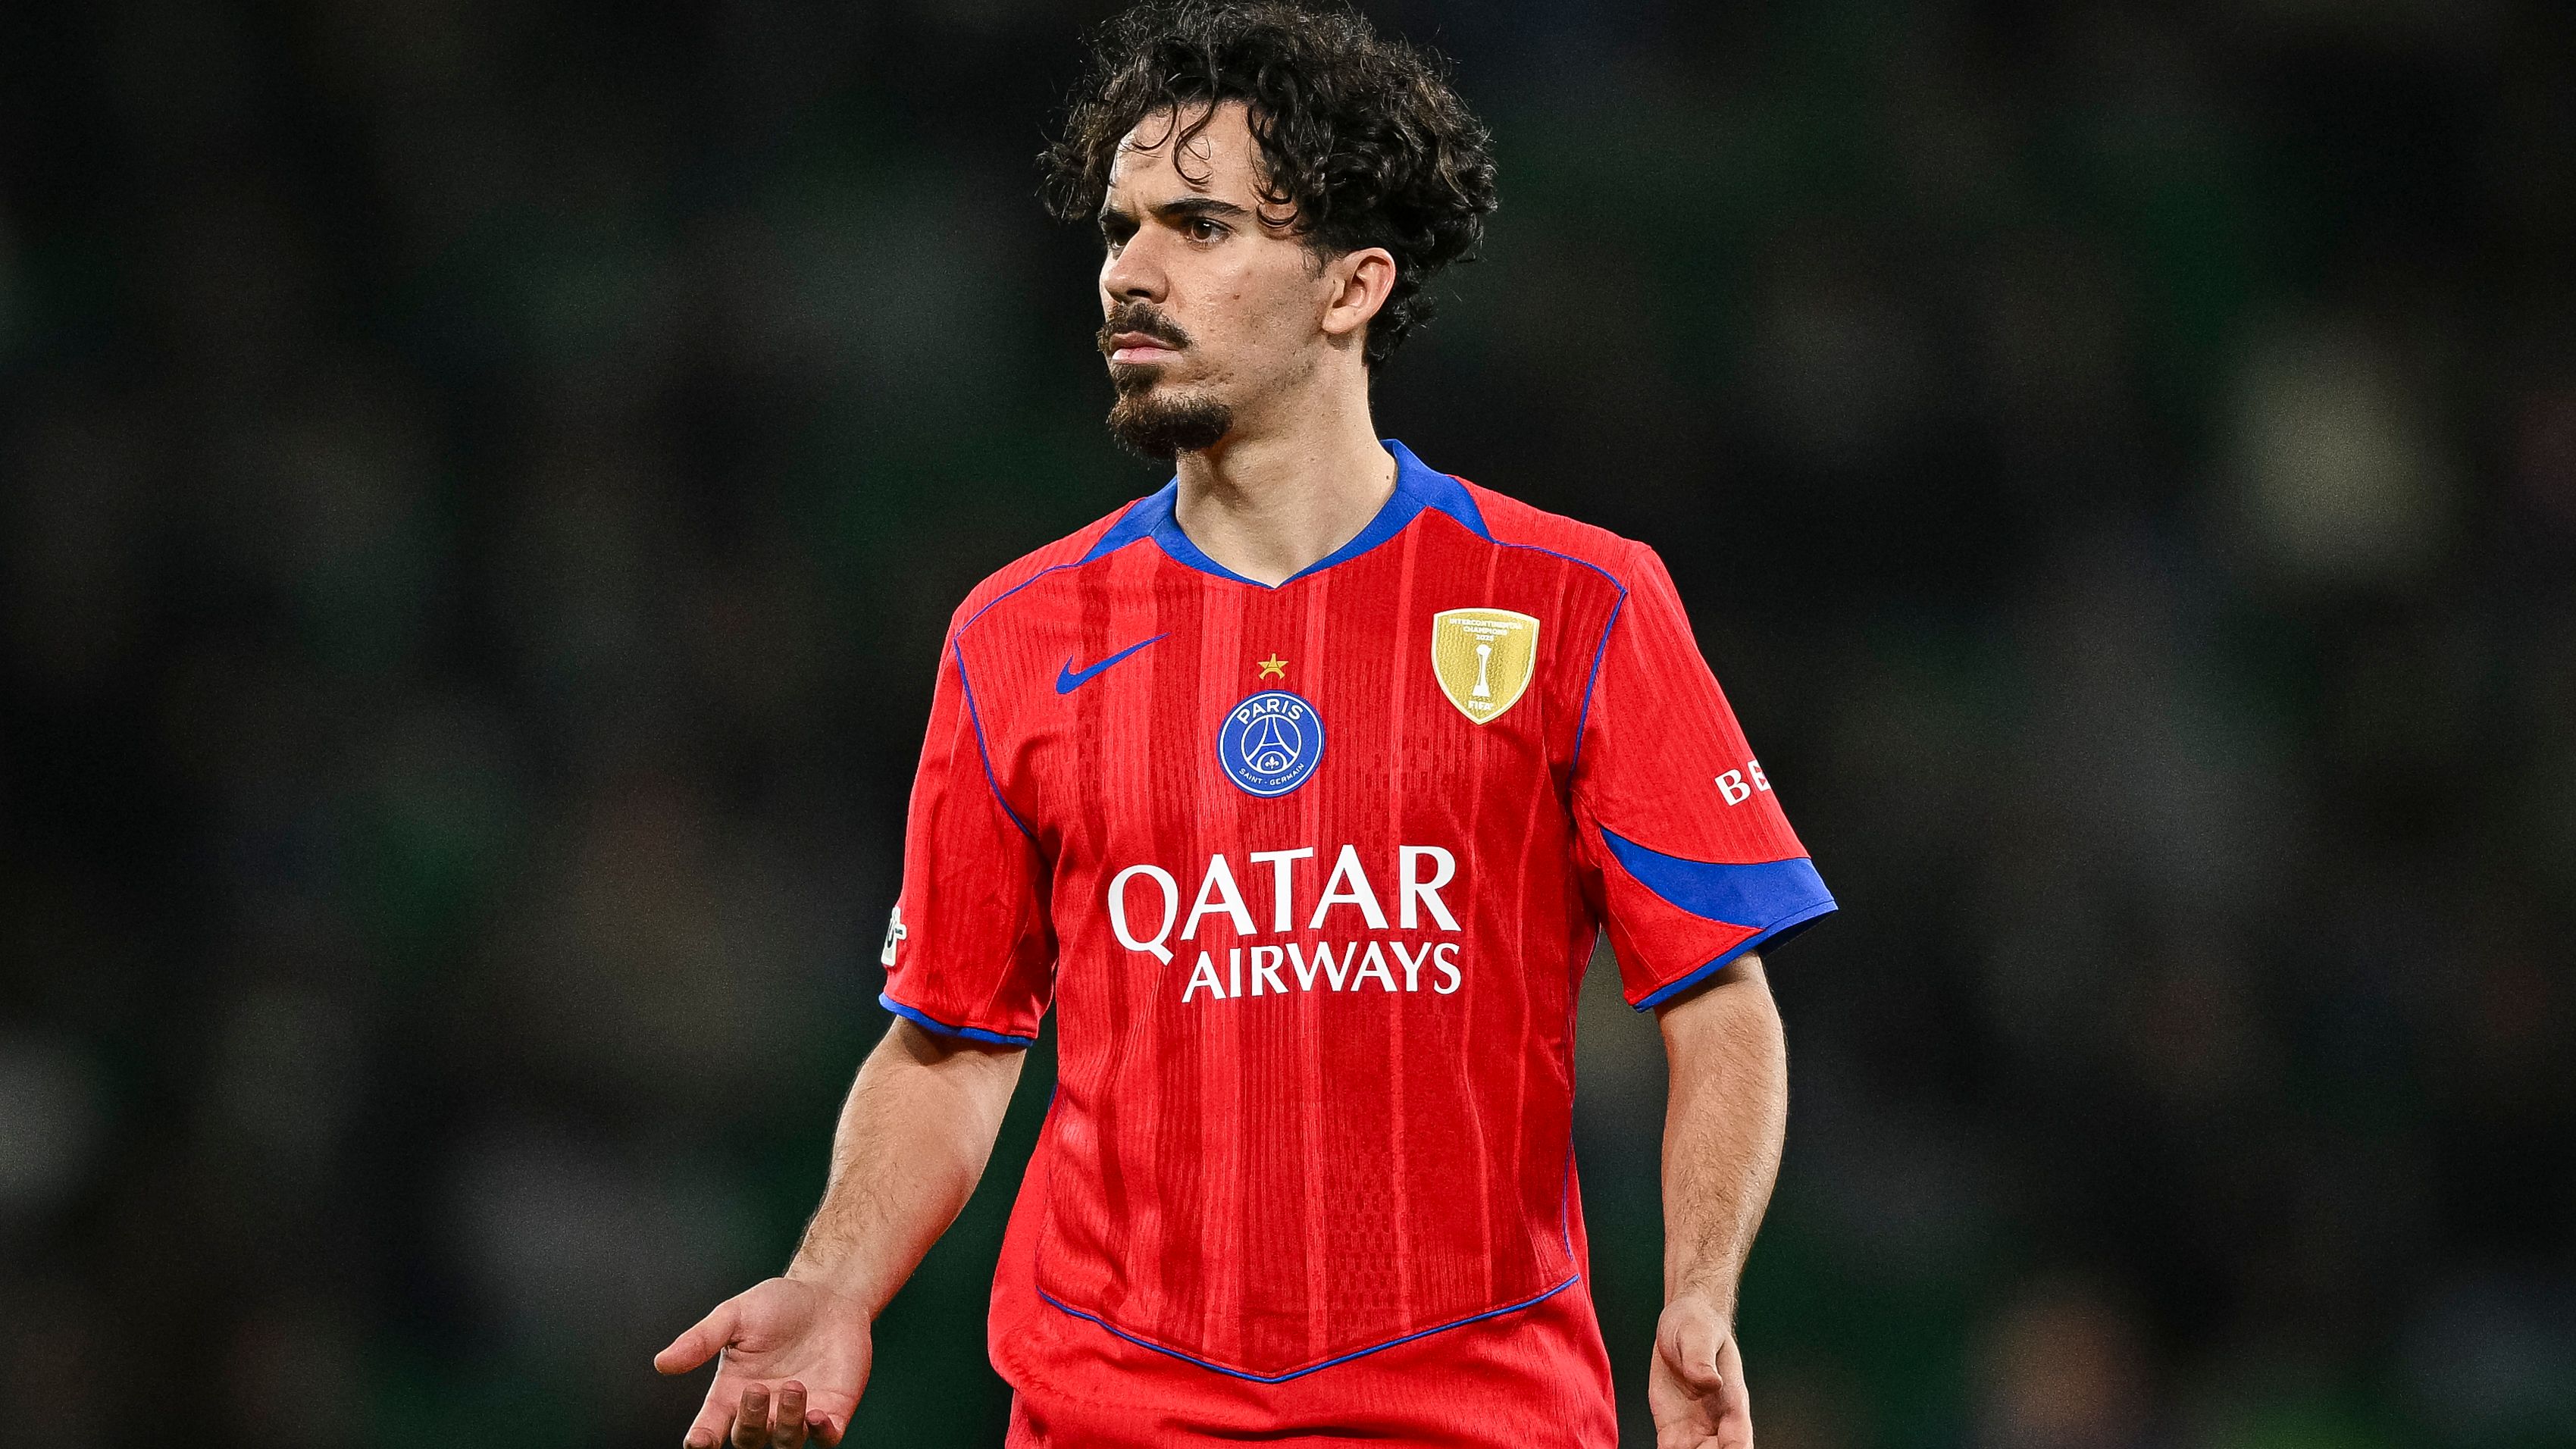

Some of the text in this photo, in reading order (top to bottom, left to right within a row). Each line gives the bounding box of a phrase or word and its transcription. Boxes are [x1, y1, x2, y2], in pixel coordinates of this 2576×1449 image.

[1236, 698, 1304, 725] PARIS
[1107, 843, 1462, 967] QATAR
[1182, 940, 1463, 1003] AIRWAYS
